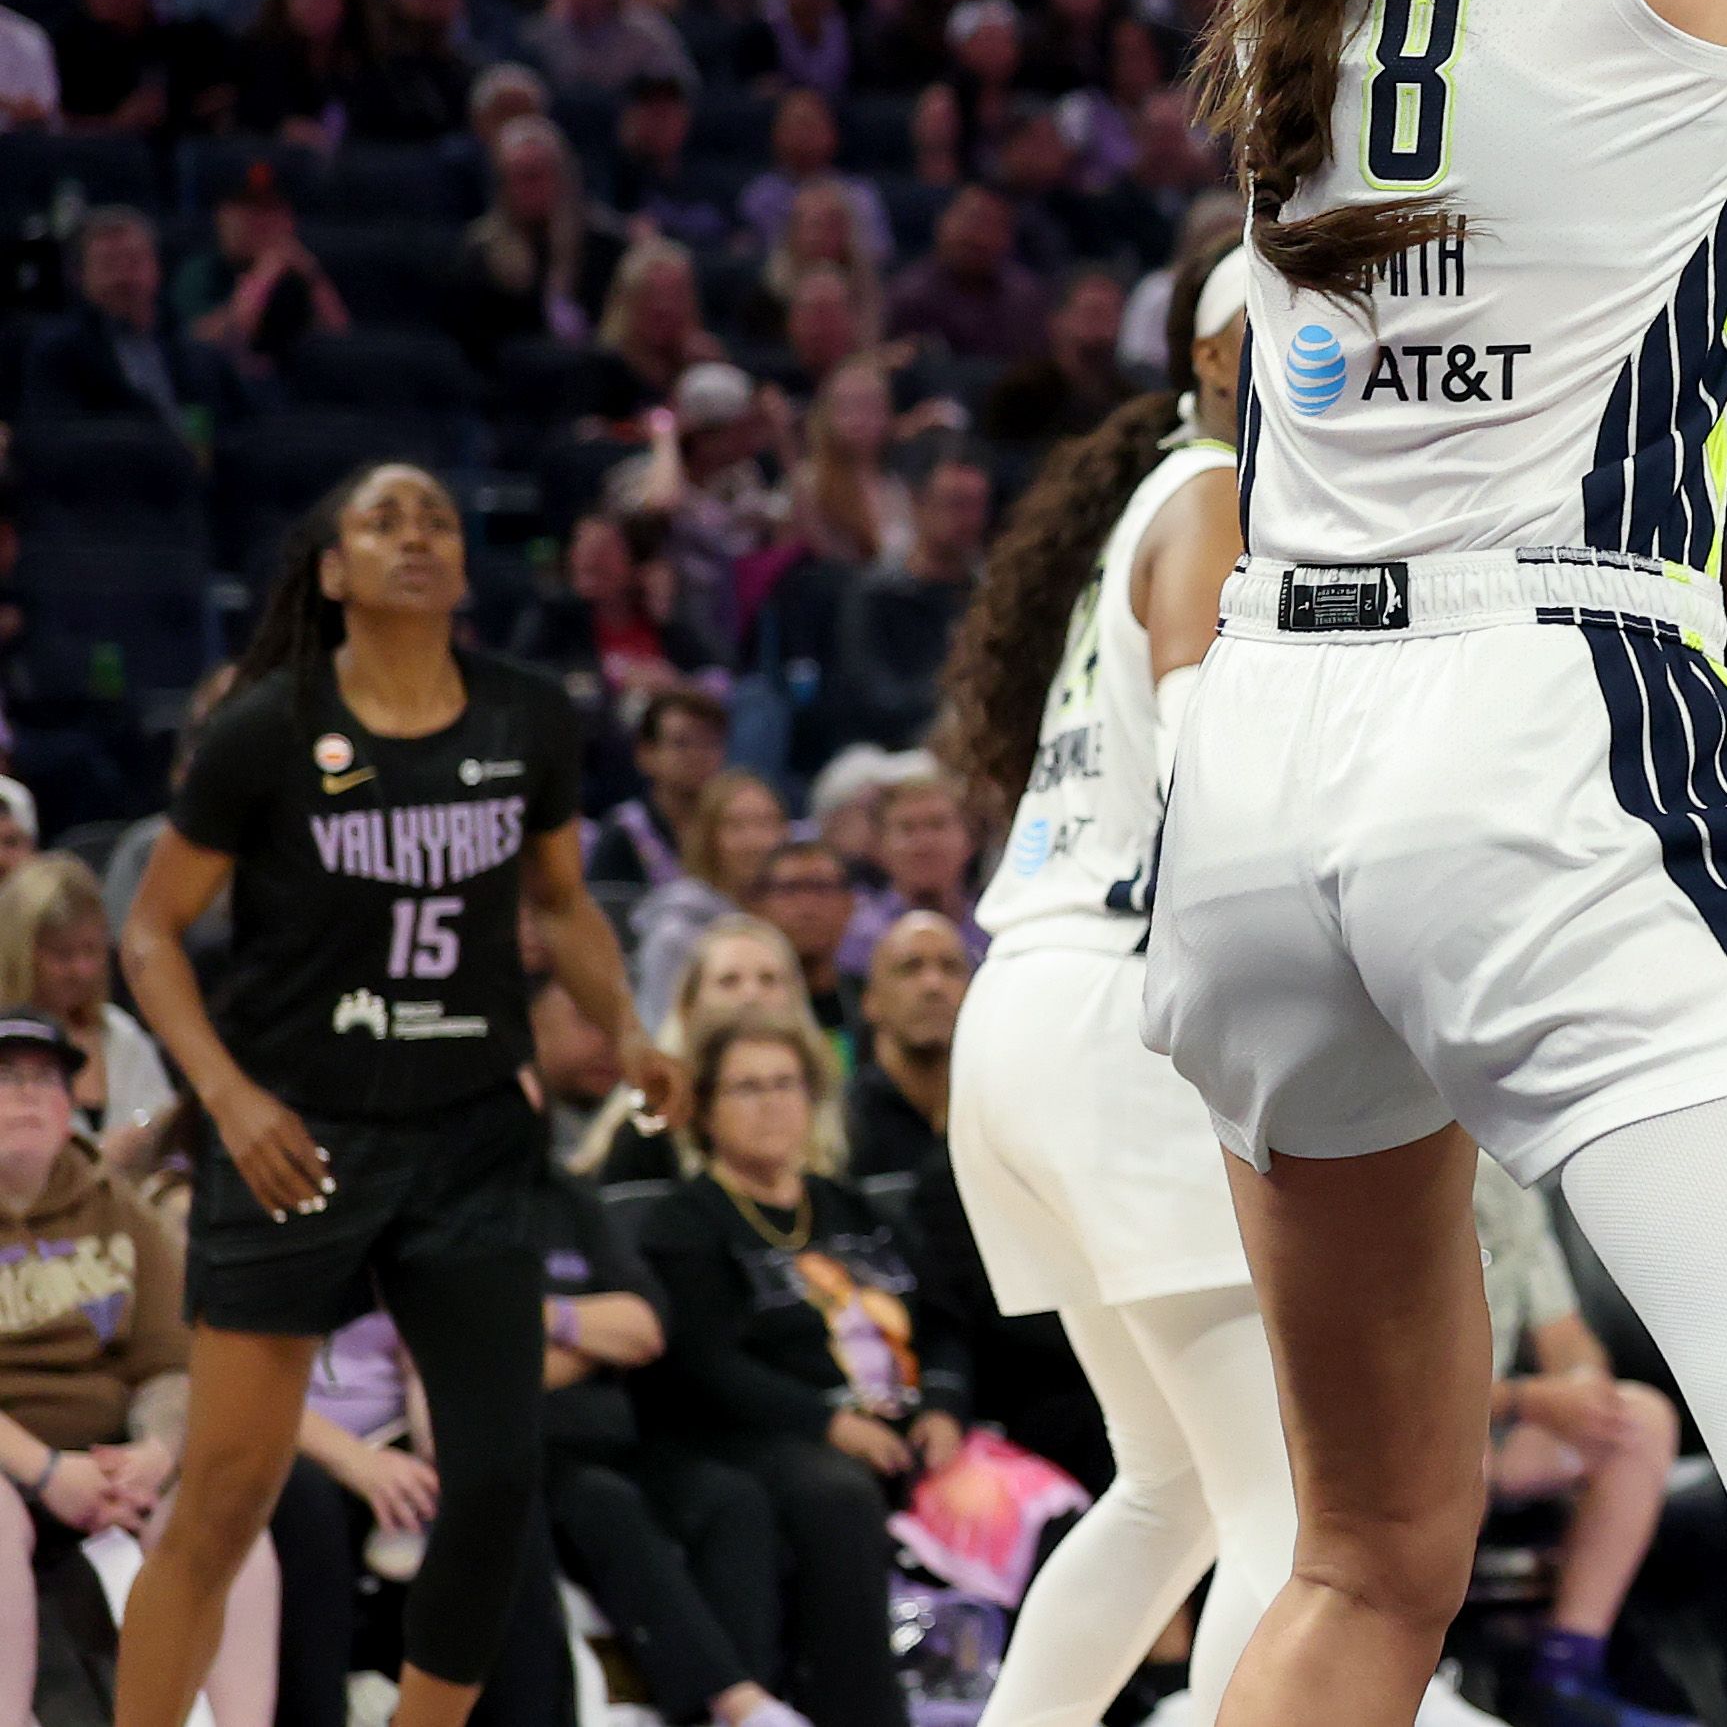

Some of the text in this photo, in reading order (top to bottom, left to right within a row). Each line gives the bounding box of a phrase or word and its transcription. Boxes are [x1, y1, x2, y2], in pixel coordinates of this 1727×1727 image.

[1361, 343, 1532, 403] AT&T
[310, 796, 525, 888] VALKYRIES
[387, 898, 465, 979] 15
